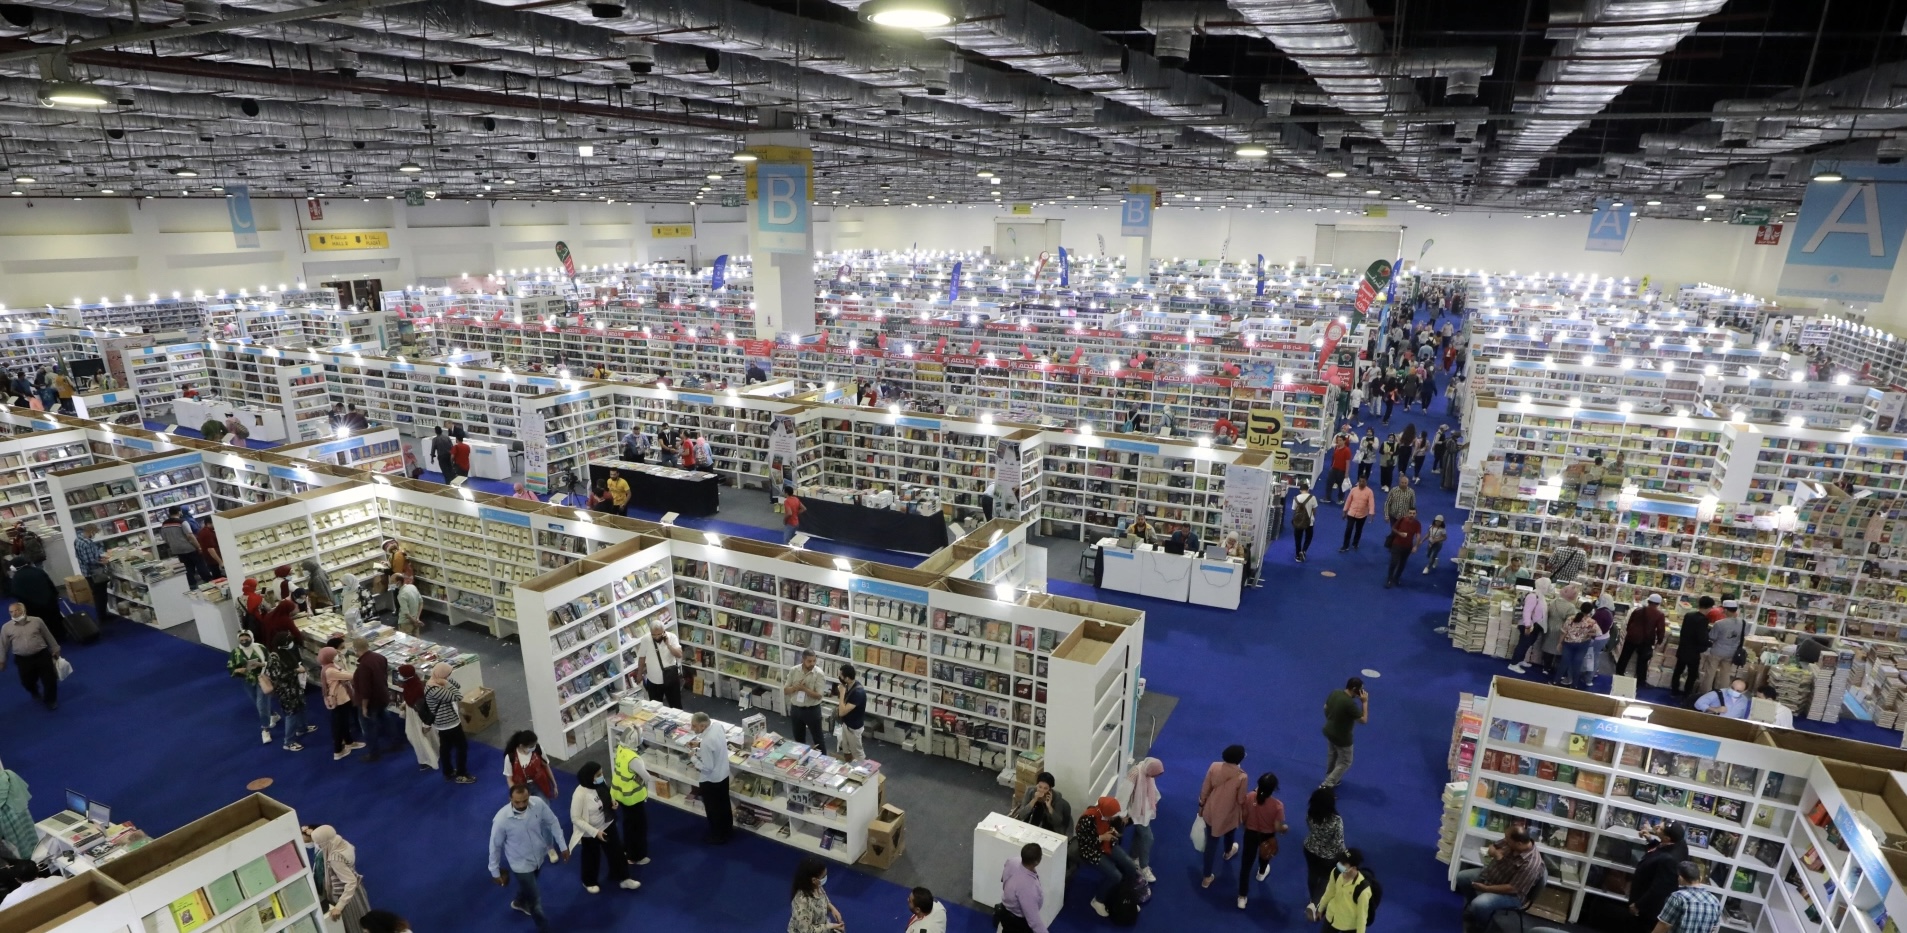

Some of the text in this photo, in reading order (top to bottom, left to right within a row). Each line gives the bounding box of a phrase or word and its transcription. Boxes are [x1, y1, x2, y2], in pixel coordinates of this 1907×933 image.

[232, 191, 251, 229] C
[767, 173, 798, 225] B
[1127, 197, 1145, 223] B
[1594, 204, 1622, 236] A
[1801, 177, 1886, 257] A
[1249, 434, 1280, 446] دارك
[861, 581, 870, 589] B1
[1596, 723, 1619, 734] A61
